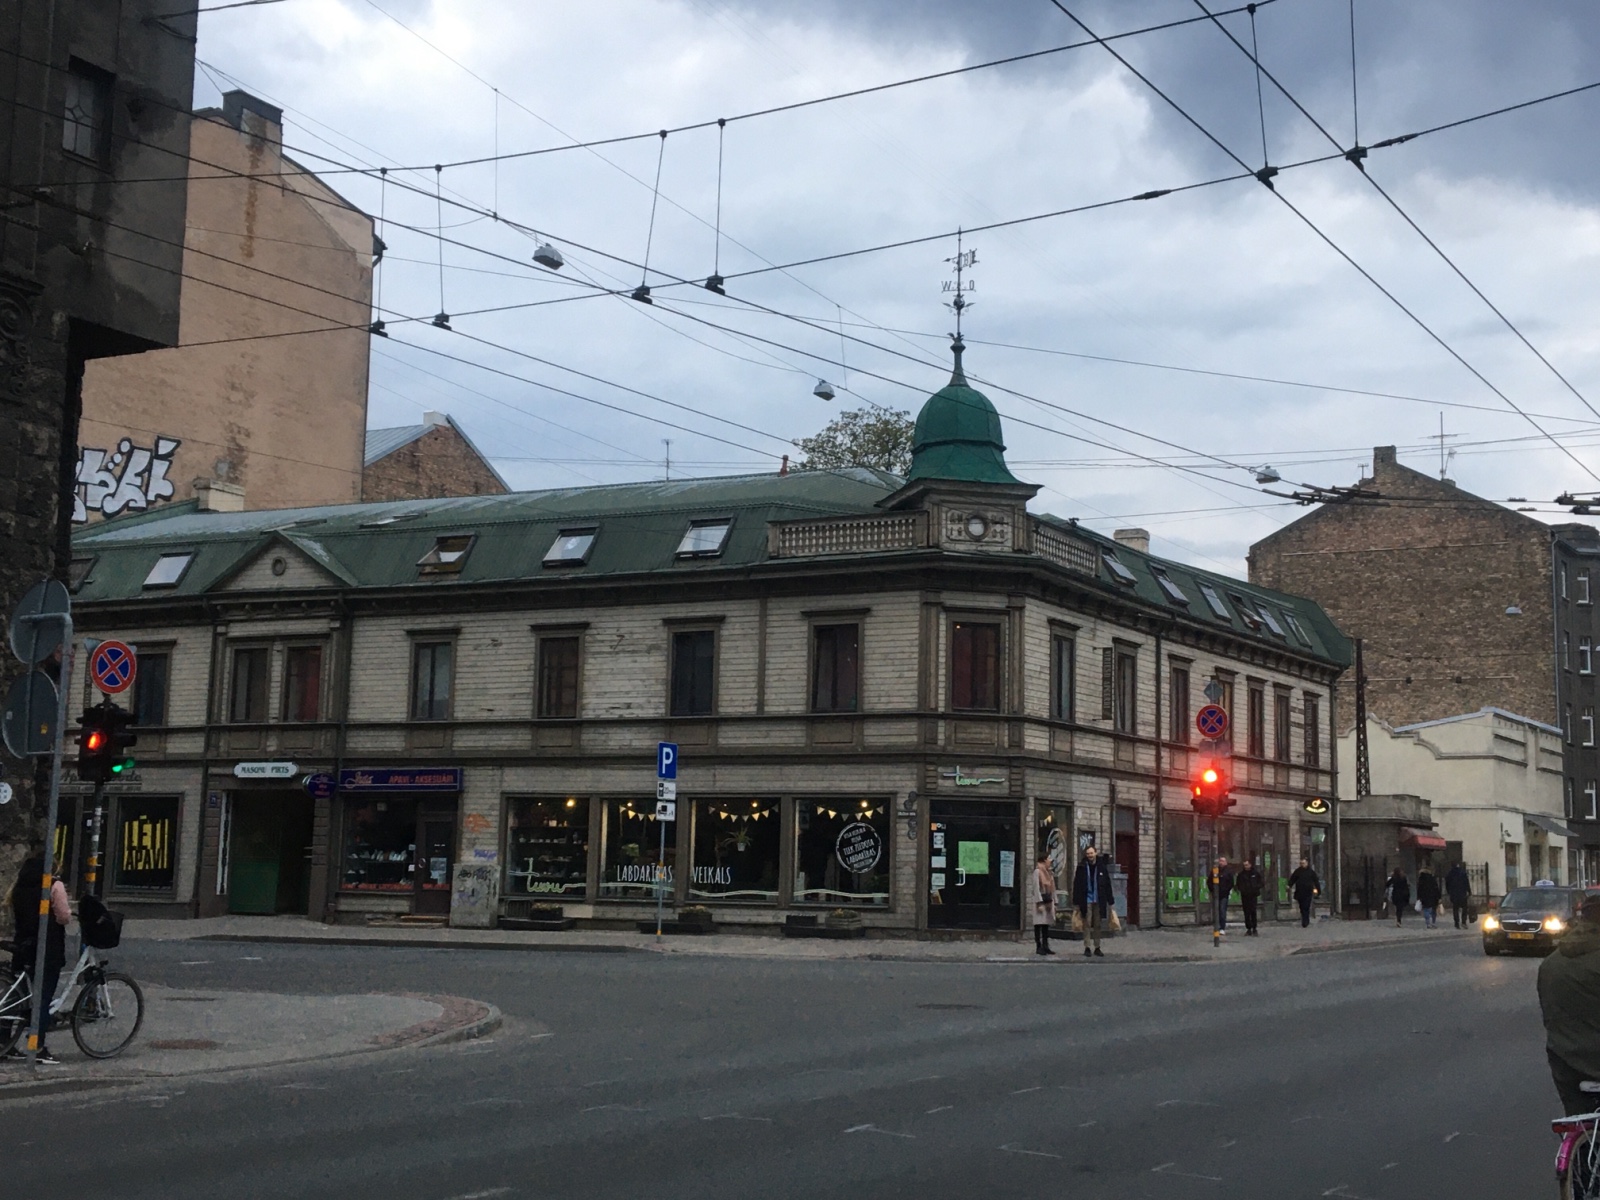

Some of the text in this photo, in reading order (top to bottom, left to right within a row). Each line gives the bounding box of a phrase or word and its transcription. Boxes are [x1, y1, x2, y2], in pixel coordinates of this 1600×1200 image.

[941, 280, 953, 292] W
[662, 747, 674, 774] P
[388, 775, 410, 784] APAVI
[617, 862, 731, 884] LABDARĪBAS VEIKALS
